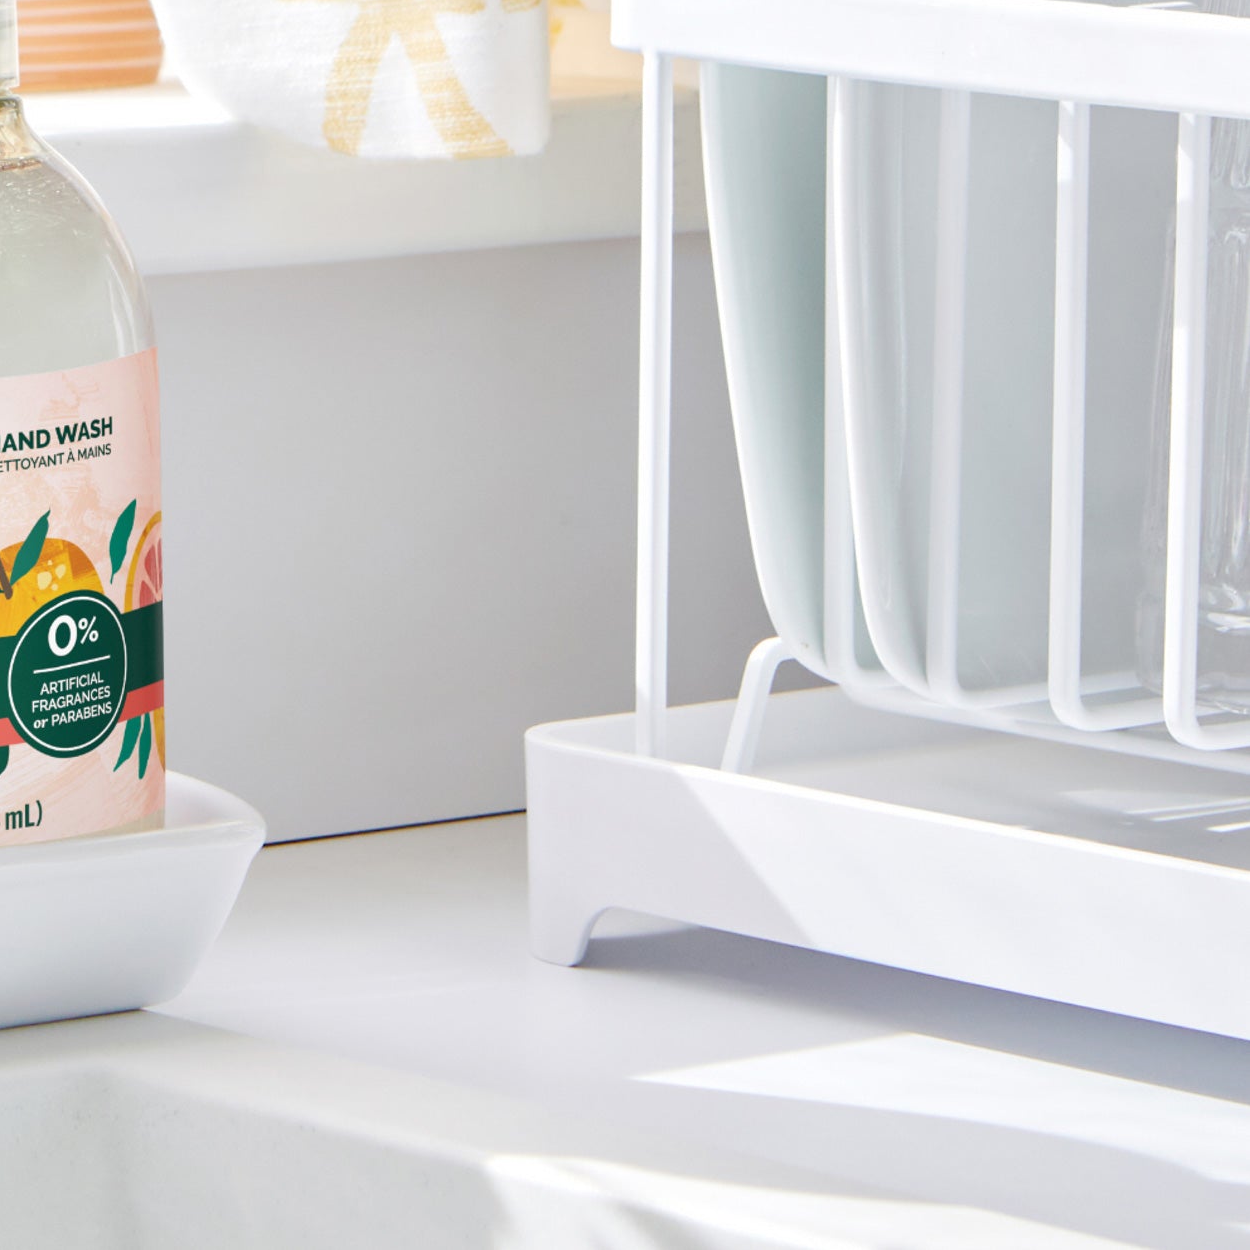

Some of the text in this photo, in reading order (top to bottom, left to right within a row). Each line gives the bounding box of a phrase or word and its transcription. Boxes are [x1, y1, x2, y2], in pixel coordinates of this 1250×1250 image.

[55, 416, 113, 445] WASH
[67, 447, 76, 464] À
[77, 443, 112, 461] MAINS
[47, 614, 100, 657] 0%
[39, 671, 105, 696] ARTIFICIAL
[31, 685, 111, 713] FRAGRANCES
[33, 701, 112, 729] or PARABENS
[5, 799, 43, 830] mL)
